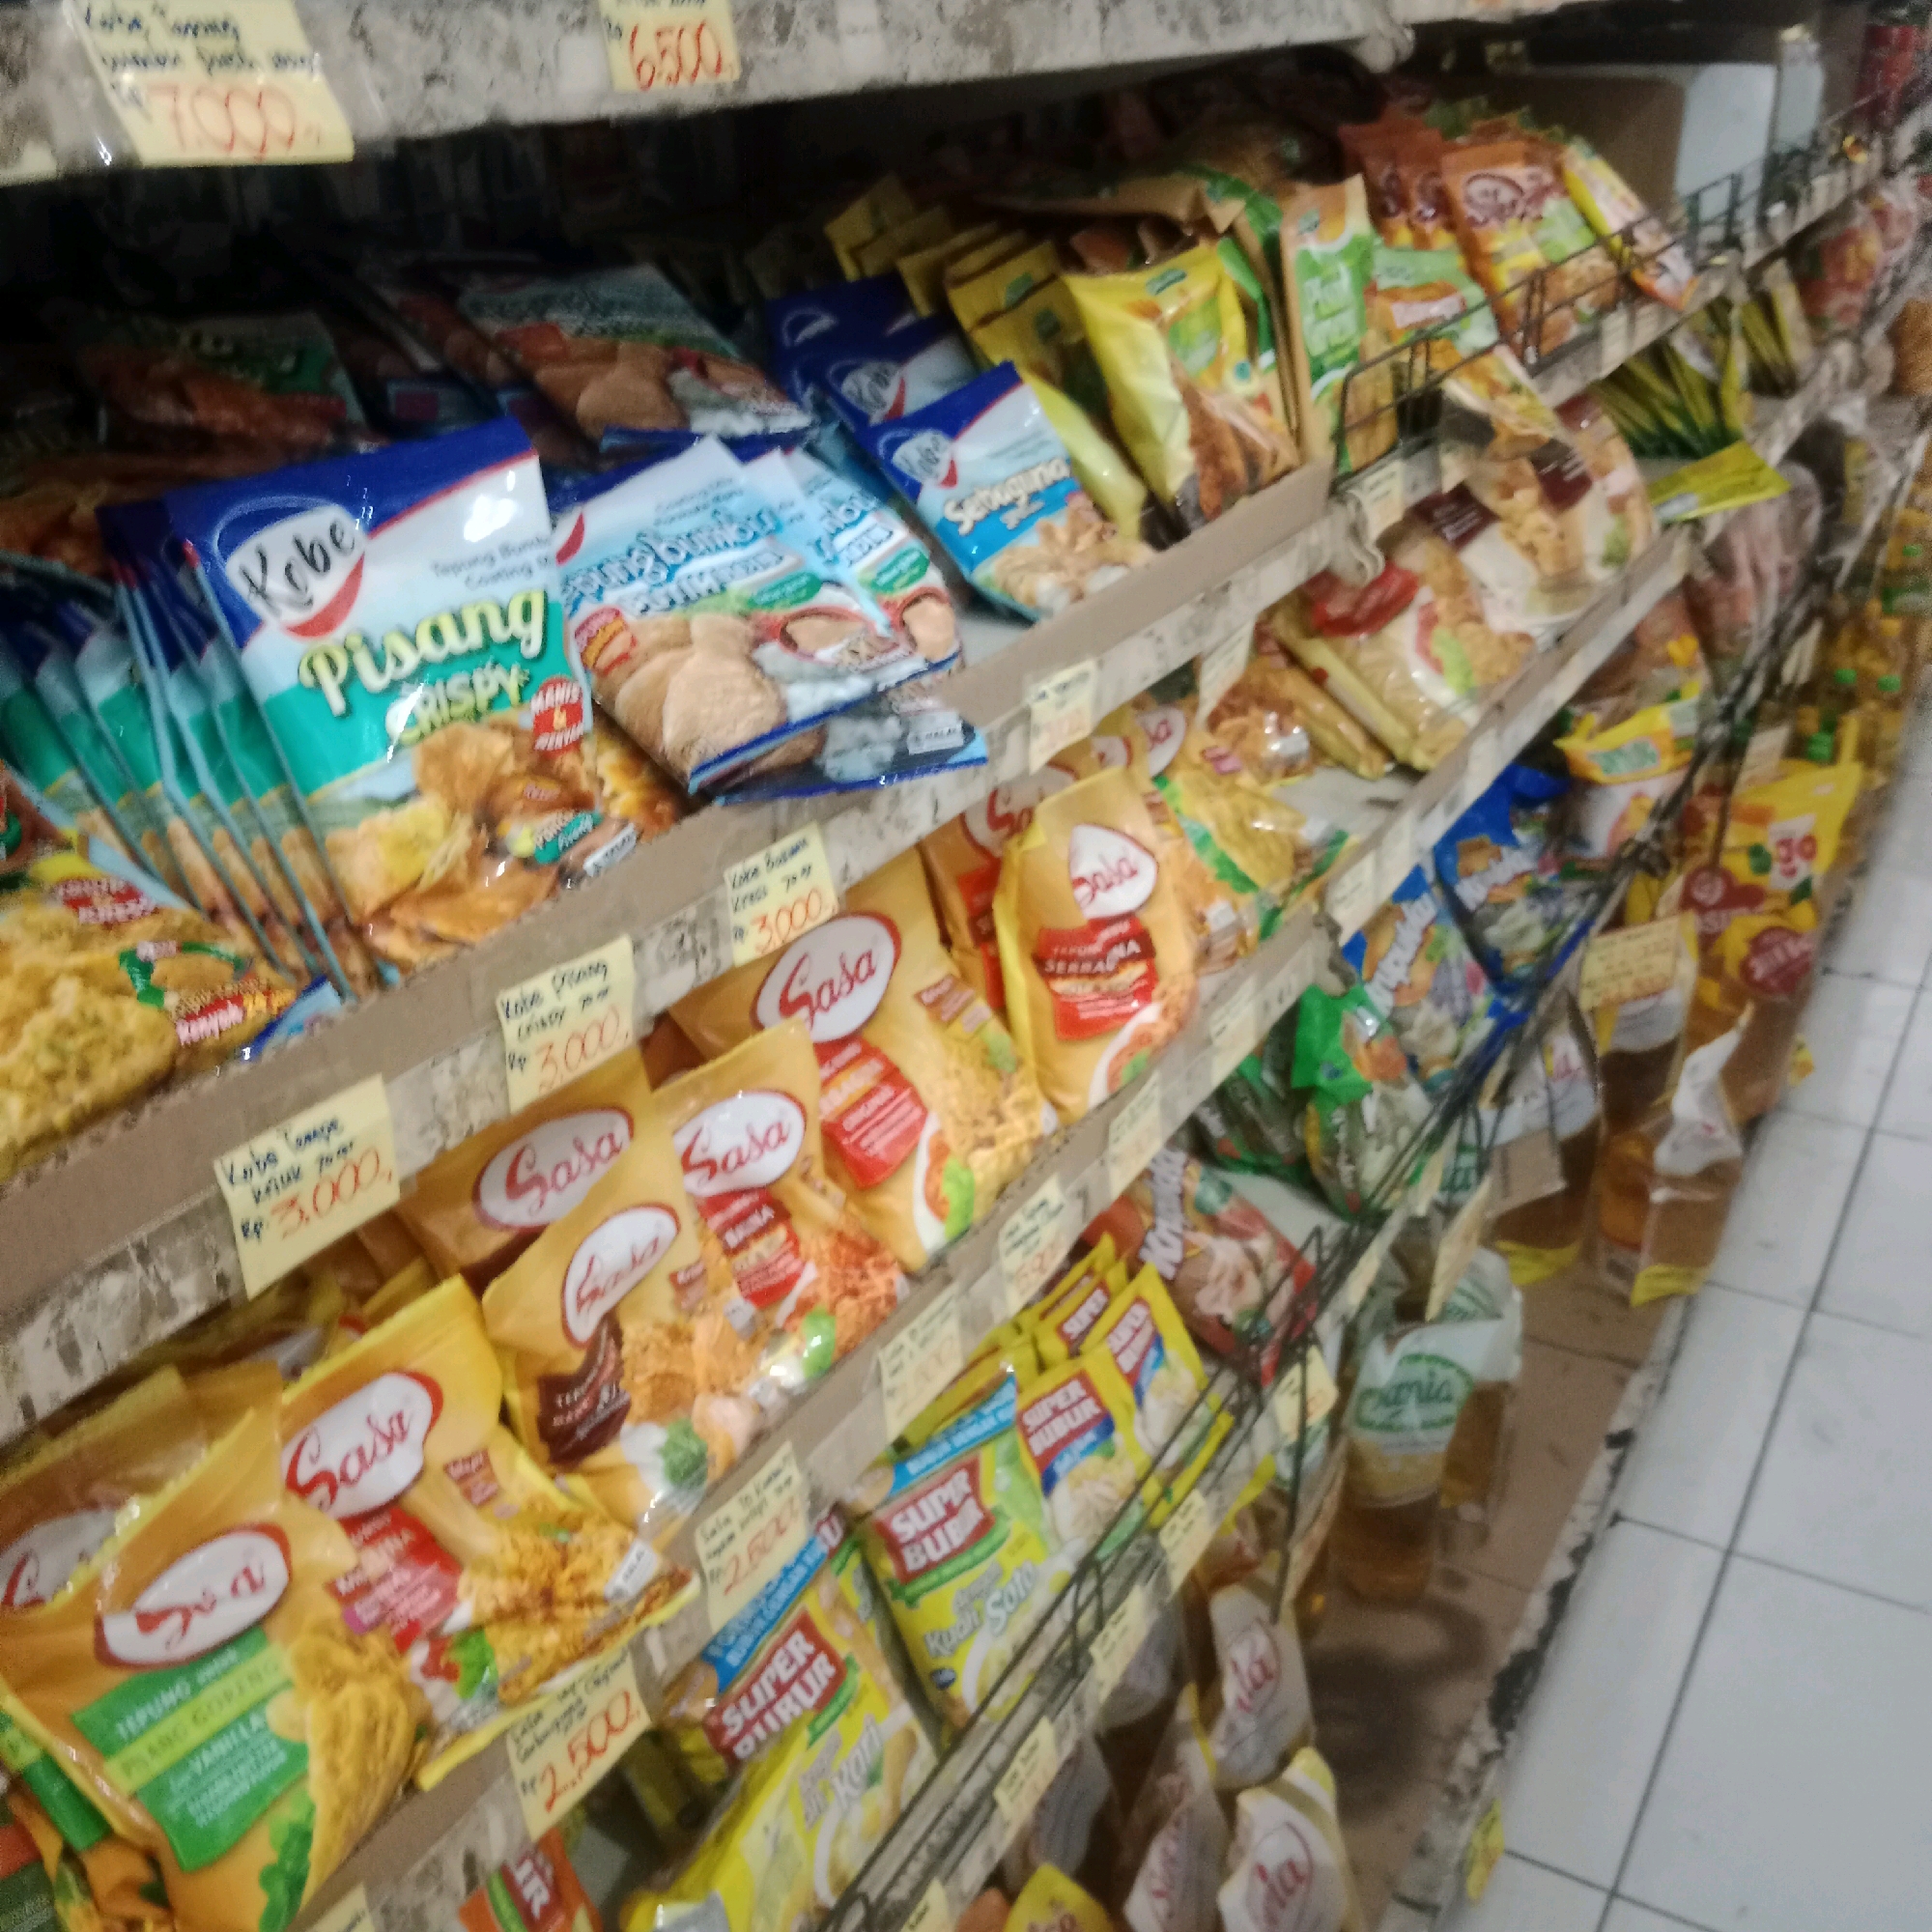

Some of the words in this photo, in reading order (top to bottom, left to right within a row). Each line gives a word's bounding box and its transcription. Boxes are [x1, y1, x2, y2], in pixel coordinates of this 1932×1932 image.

[238, 517, 357, 618] Kobe
[297, 587, 552, 719] Pisang
[384, 653, 532, 752] CRISPY
[779, 947, 879, 1032] Sasa
[505, 1130, 624, 1217] Sasa
[680, 1119, 791, 1188] Sasa
[1021, 1378, 1088, 1435] SUPER
[1027, 1396, 1103, 1458] BUBUR
[285, 1408, 413, 1514] Sasa
[889, 1466, 972, 1545] SUPER
[984, 1558, 1038, 1635] Soto
[722, 1629, 817, 1740] SUPER
